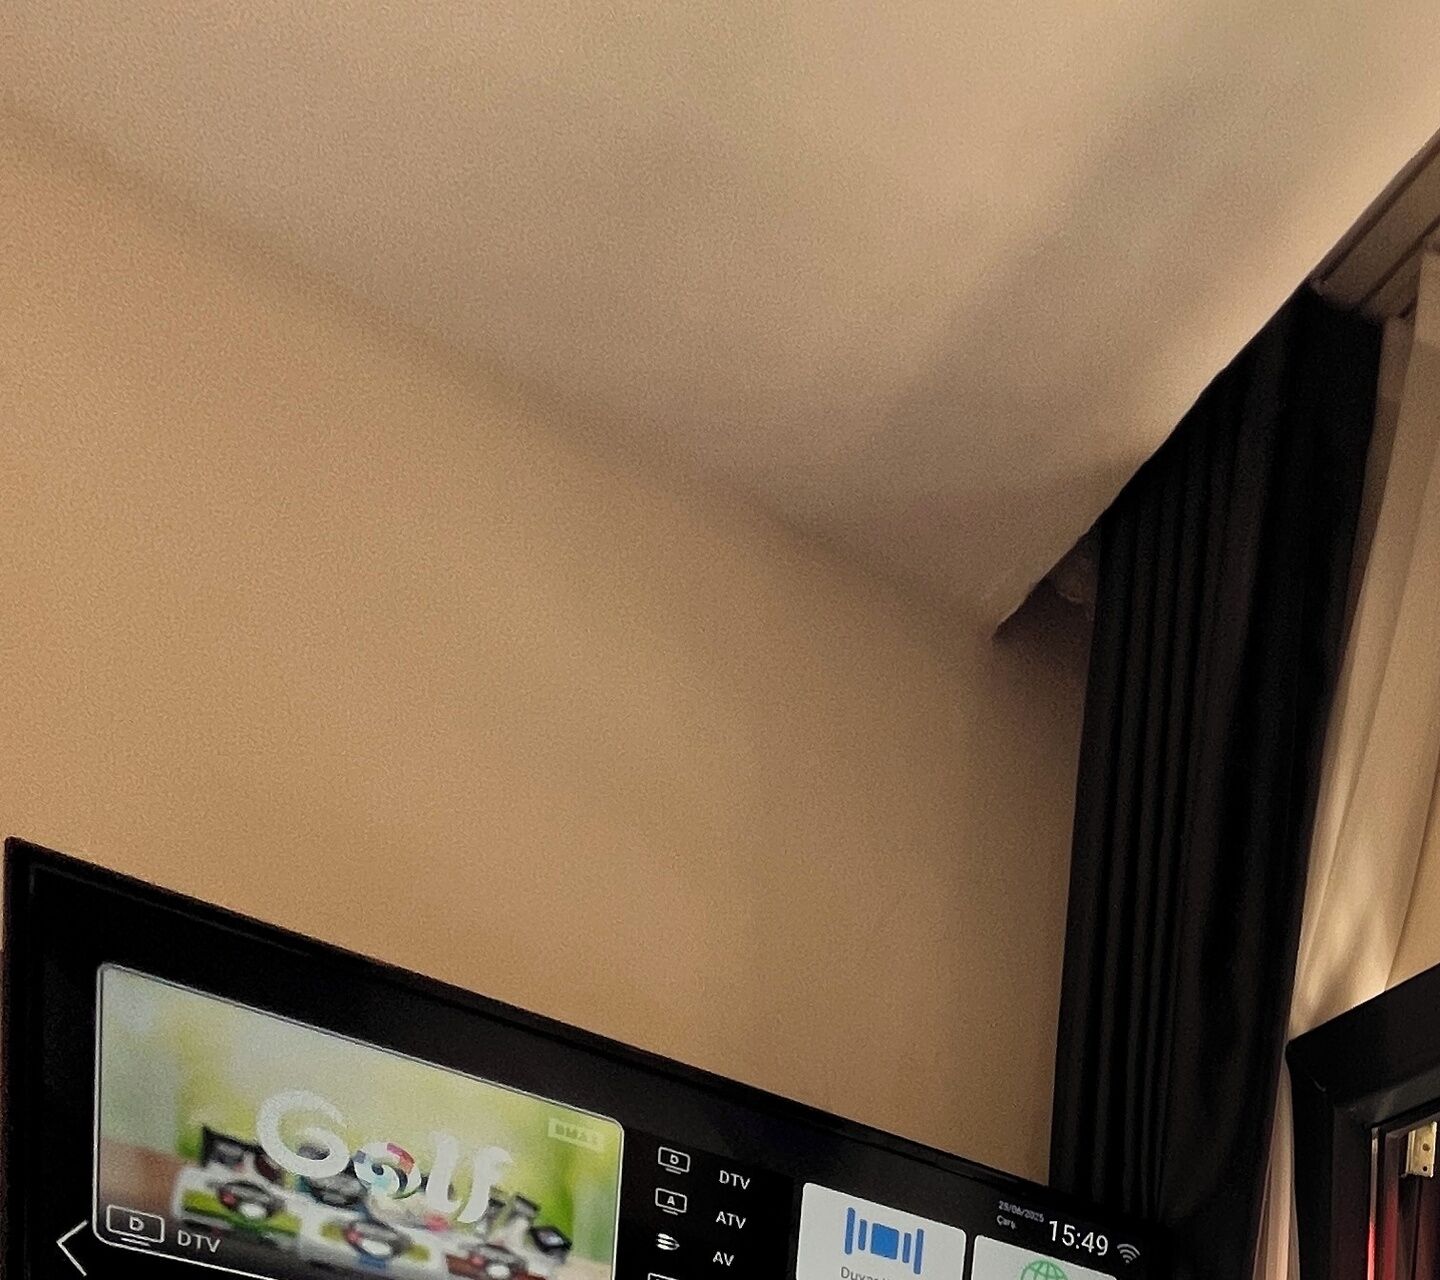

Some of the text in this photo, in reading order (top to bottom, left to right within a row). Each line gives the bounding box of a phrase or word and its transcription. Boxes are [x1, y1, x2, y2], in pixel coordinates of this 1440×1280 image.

[718, 1170, 751, 1190] DTV
[715, 1211, 747, 1229] ATV
[177, 1229, 222, 1254] DTV
[1049, 1220, 1109, 1256] 15:49
[712, 1251, 735, 1267] AV
